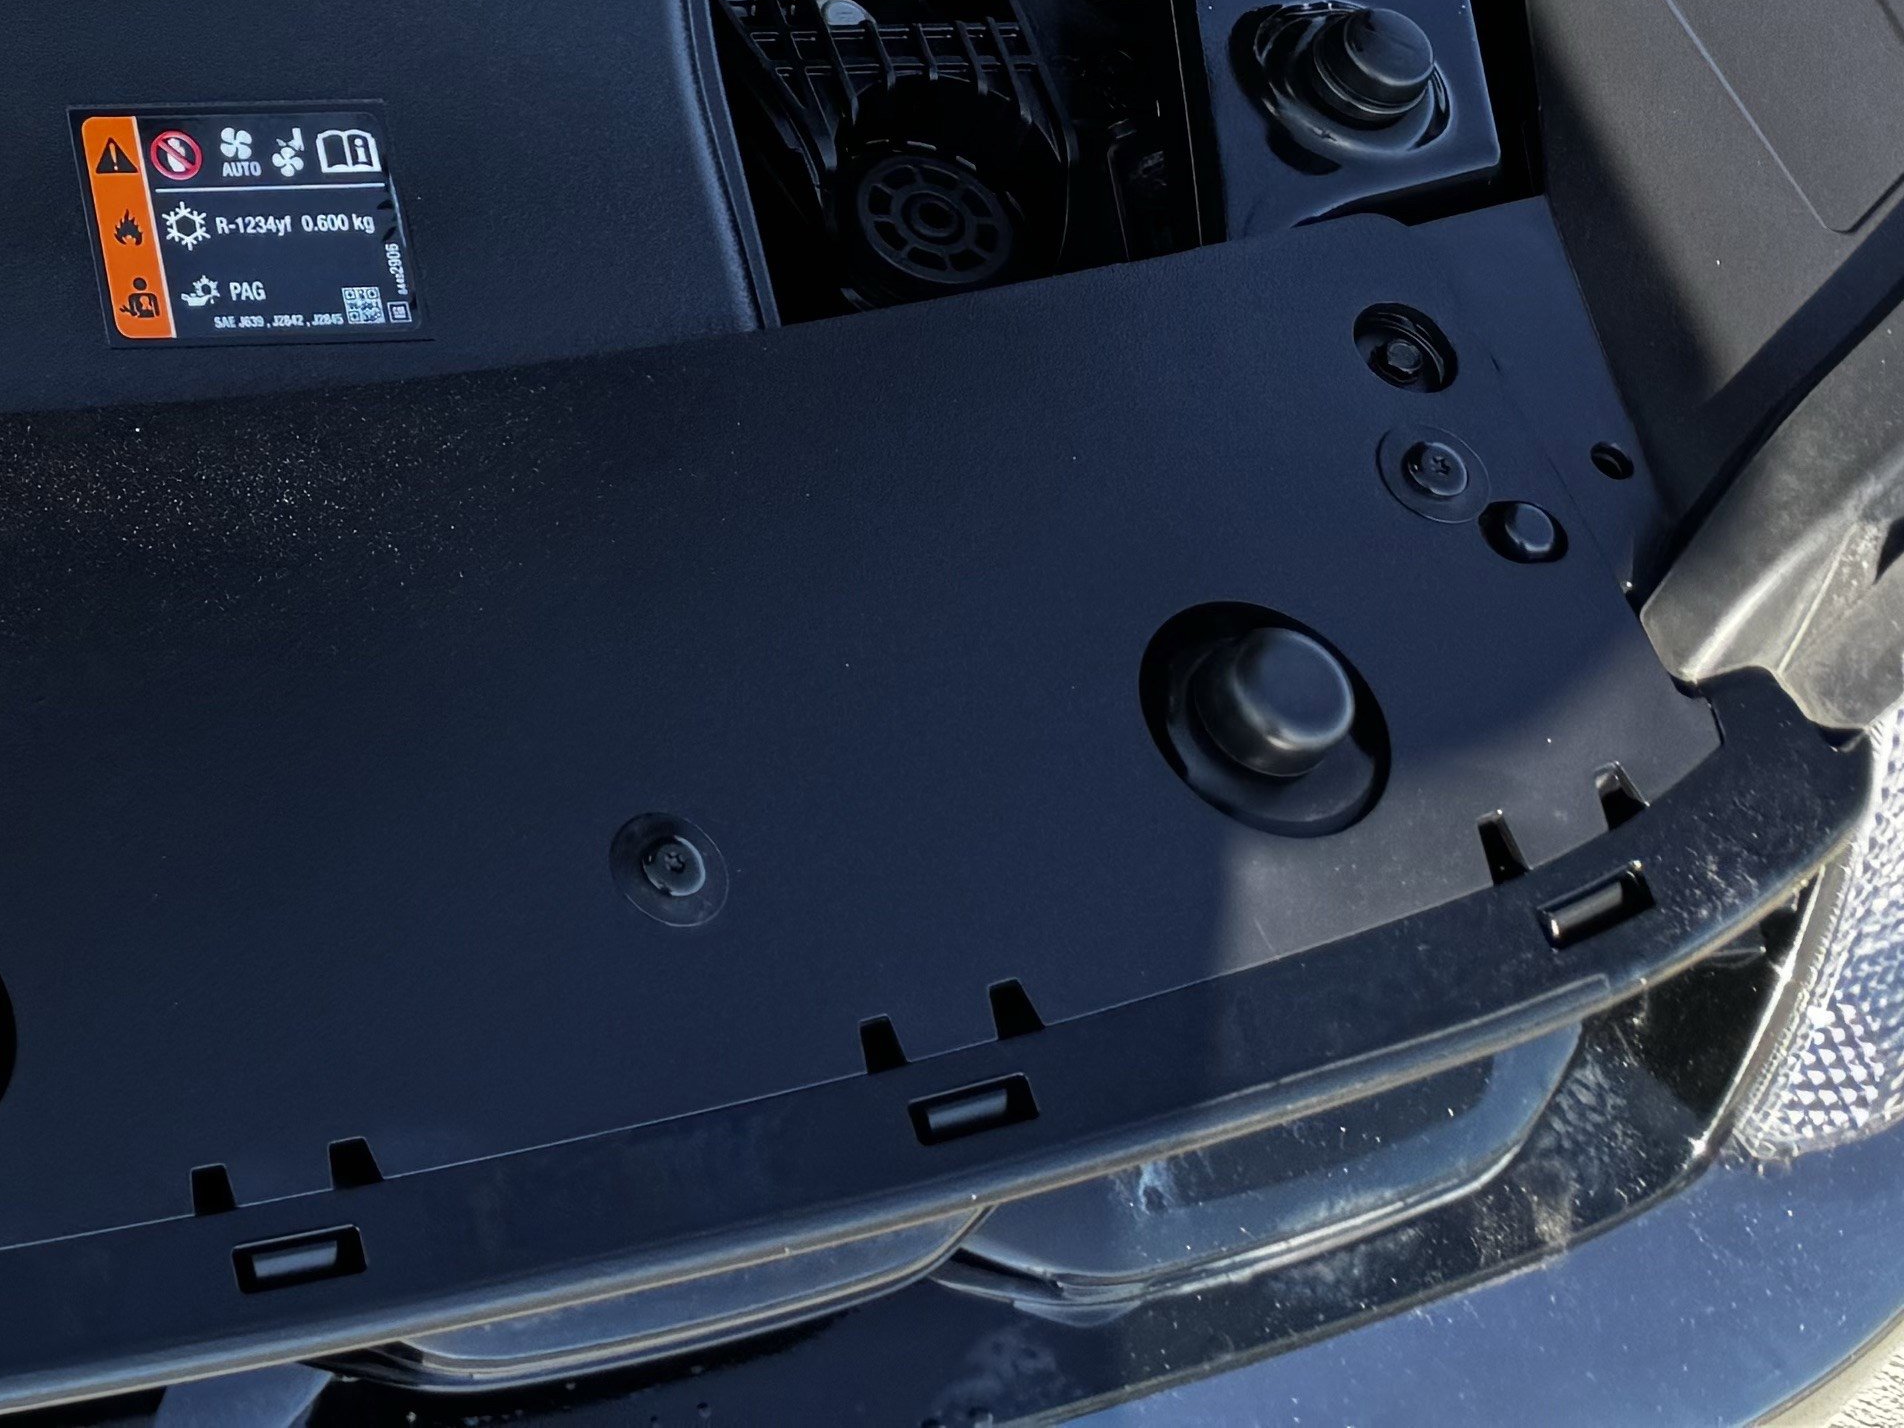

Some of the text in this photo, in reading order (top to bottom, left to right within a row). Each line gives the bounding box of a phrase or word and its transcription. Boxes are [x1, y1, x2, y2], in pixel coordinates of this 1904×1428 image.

[221, 161, 262, 178] AUTO
[215, 213, 376, 237] R-1234yf 0.600 kg
[229, 281, 267, 302] PAG
